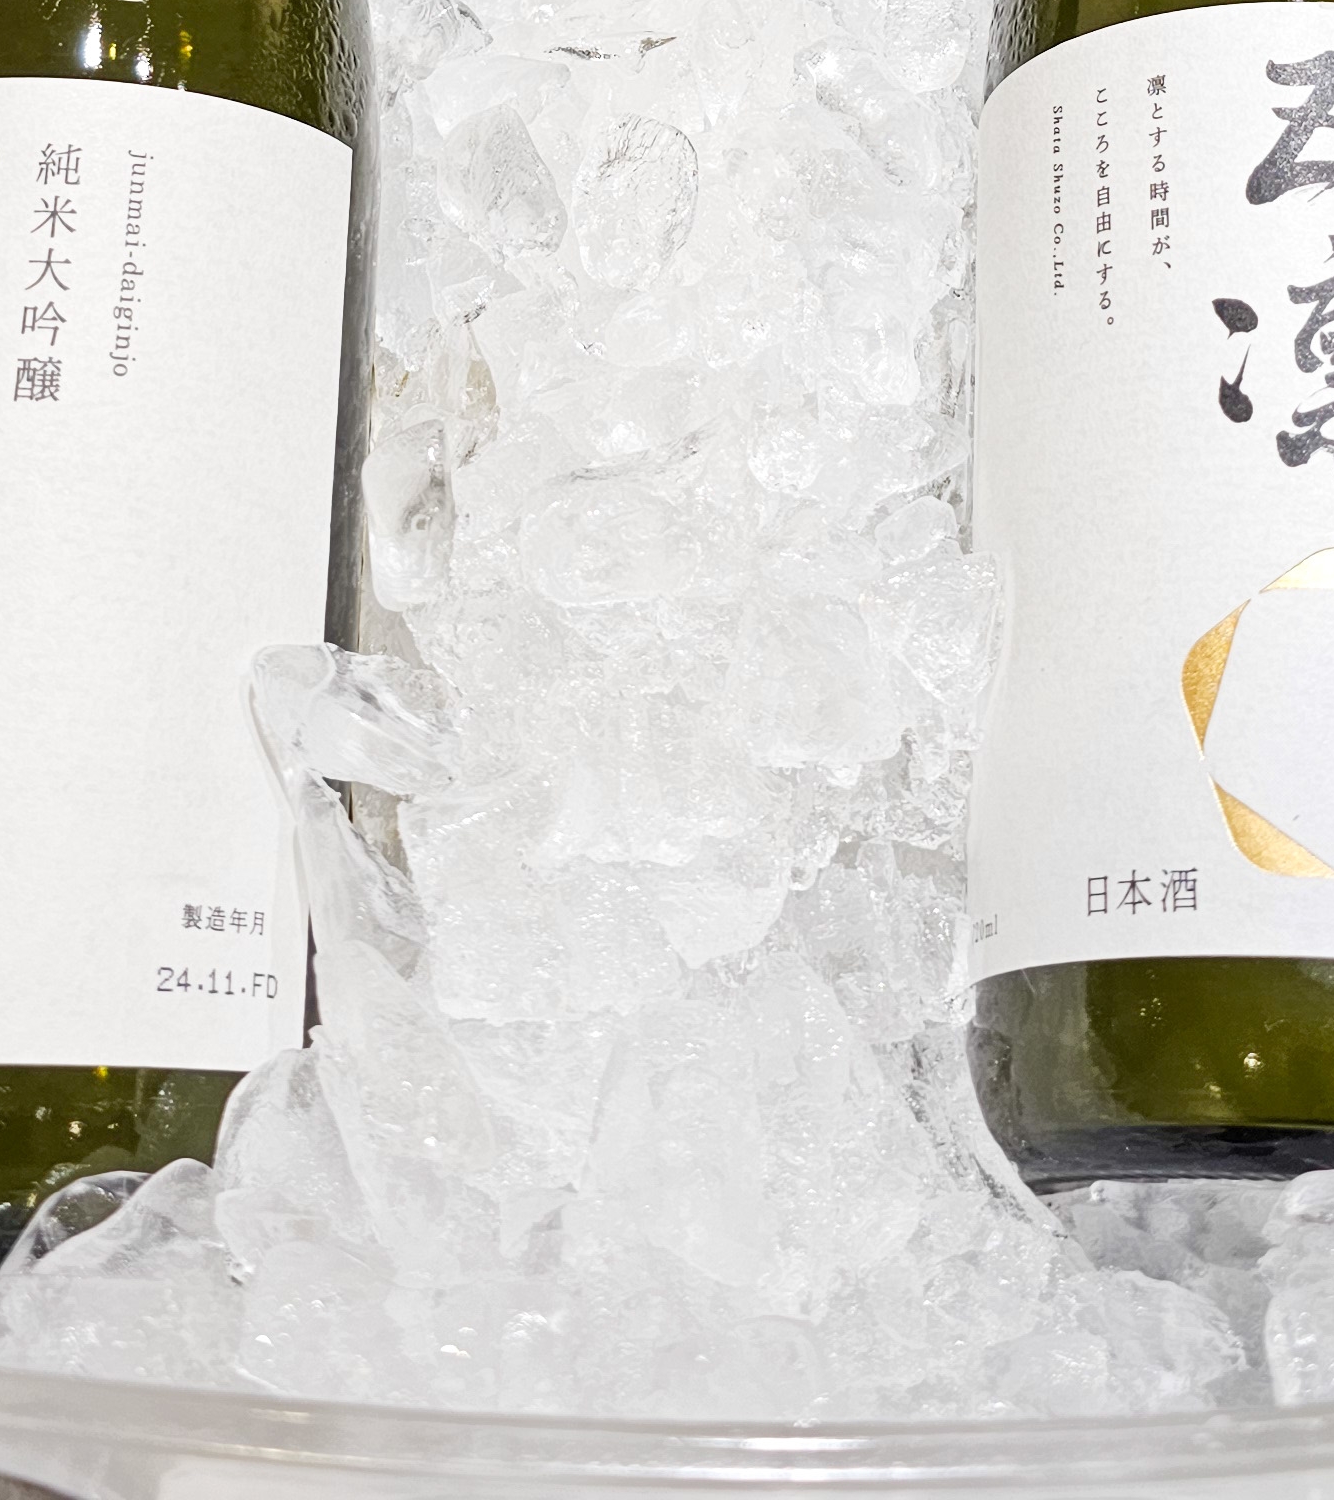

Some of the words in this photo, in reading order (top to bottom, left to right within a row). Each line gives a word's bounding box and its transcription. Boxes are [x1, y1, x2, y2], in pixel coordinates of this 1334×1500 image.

[1052, 104, 1063, 155] Shata
[1052, 162, 1064, 215] Shuzo
[1094, 87, 1115, 326] こころを自由にする。
[13, 142, 83, 402] 純米大吟醸
[109, 149, 155, 378] junmai-daiginjo
[1086, 867, 1199, 917] 日本酒
[181, 903, 266, 936] 製造年月
[156, 966, 279, 1000] 24.11.FD
